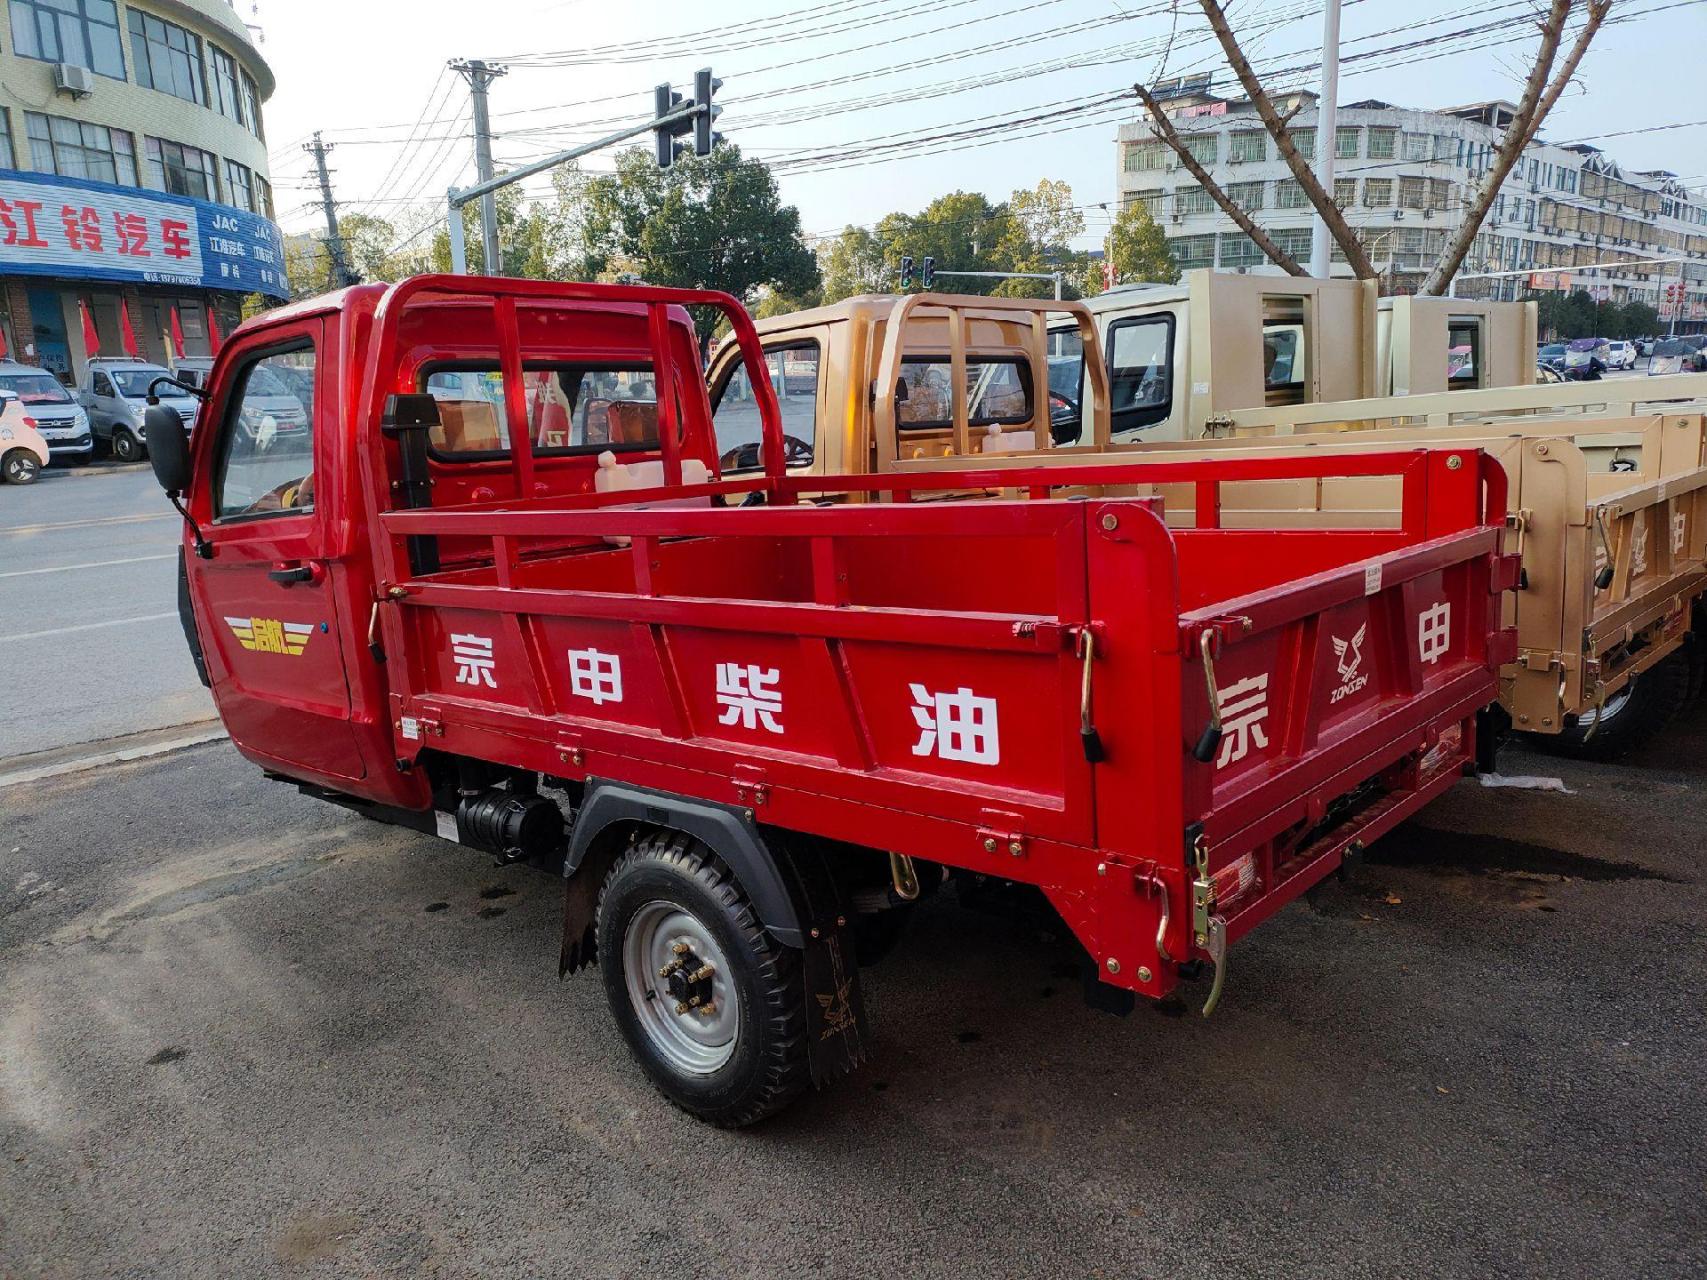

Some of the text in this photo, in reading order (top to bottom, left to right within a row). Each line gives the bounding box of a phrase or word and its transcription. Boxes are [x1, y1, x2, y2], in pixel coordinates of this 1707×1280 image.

[0, 198, 191, 260] 江铃汽车
[209, 236, 246, 257] 江淮汽车
[212, 215, 239, 232] JAC
[254, 225, 272, 242] JAC
[1418, 602, 1450, 665] 申
[450, 633, 1000, 766] 宗申柴油
[1329, 673, 1369, 705] ZONSEN
[1217, 672, 1269, 770] 宗
